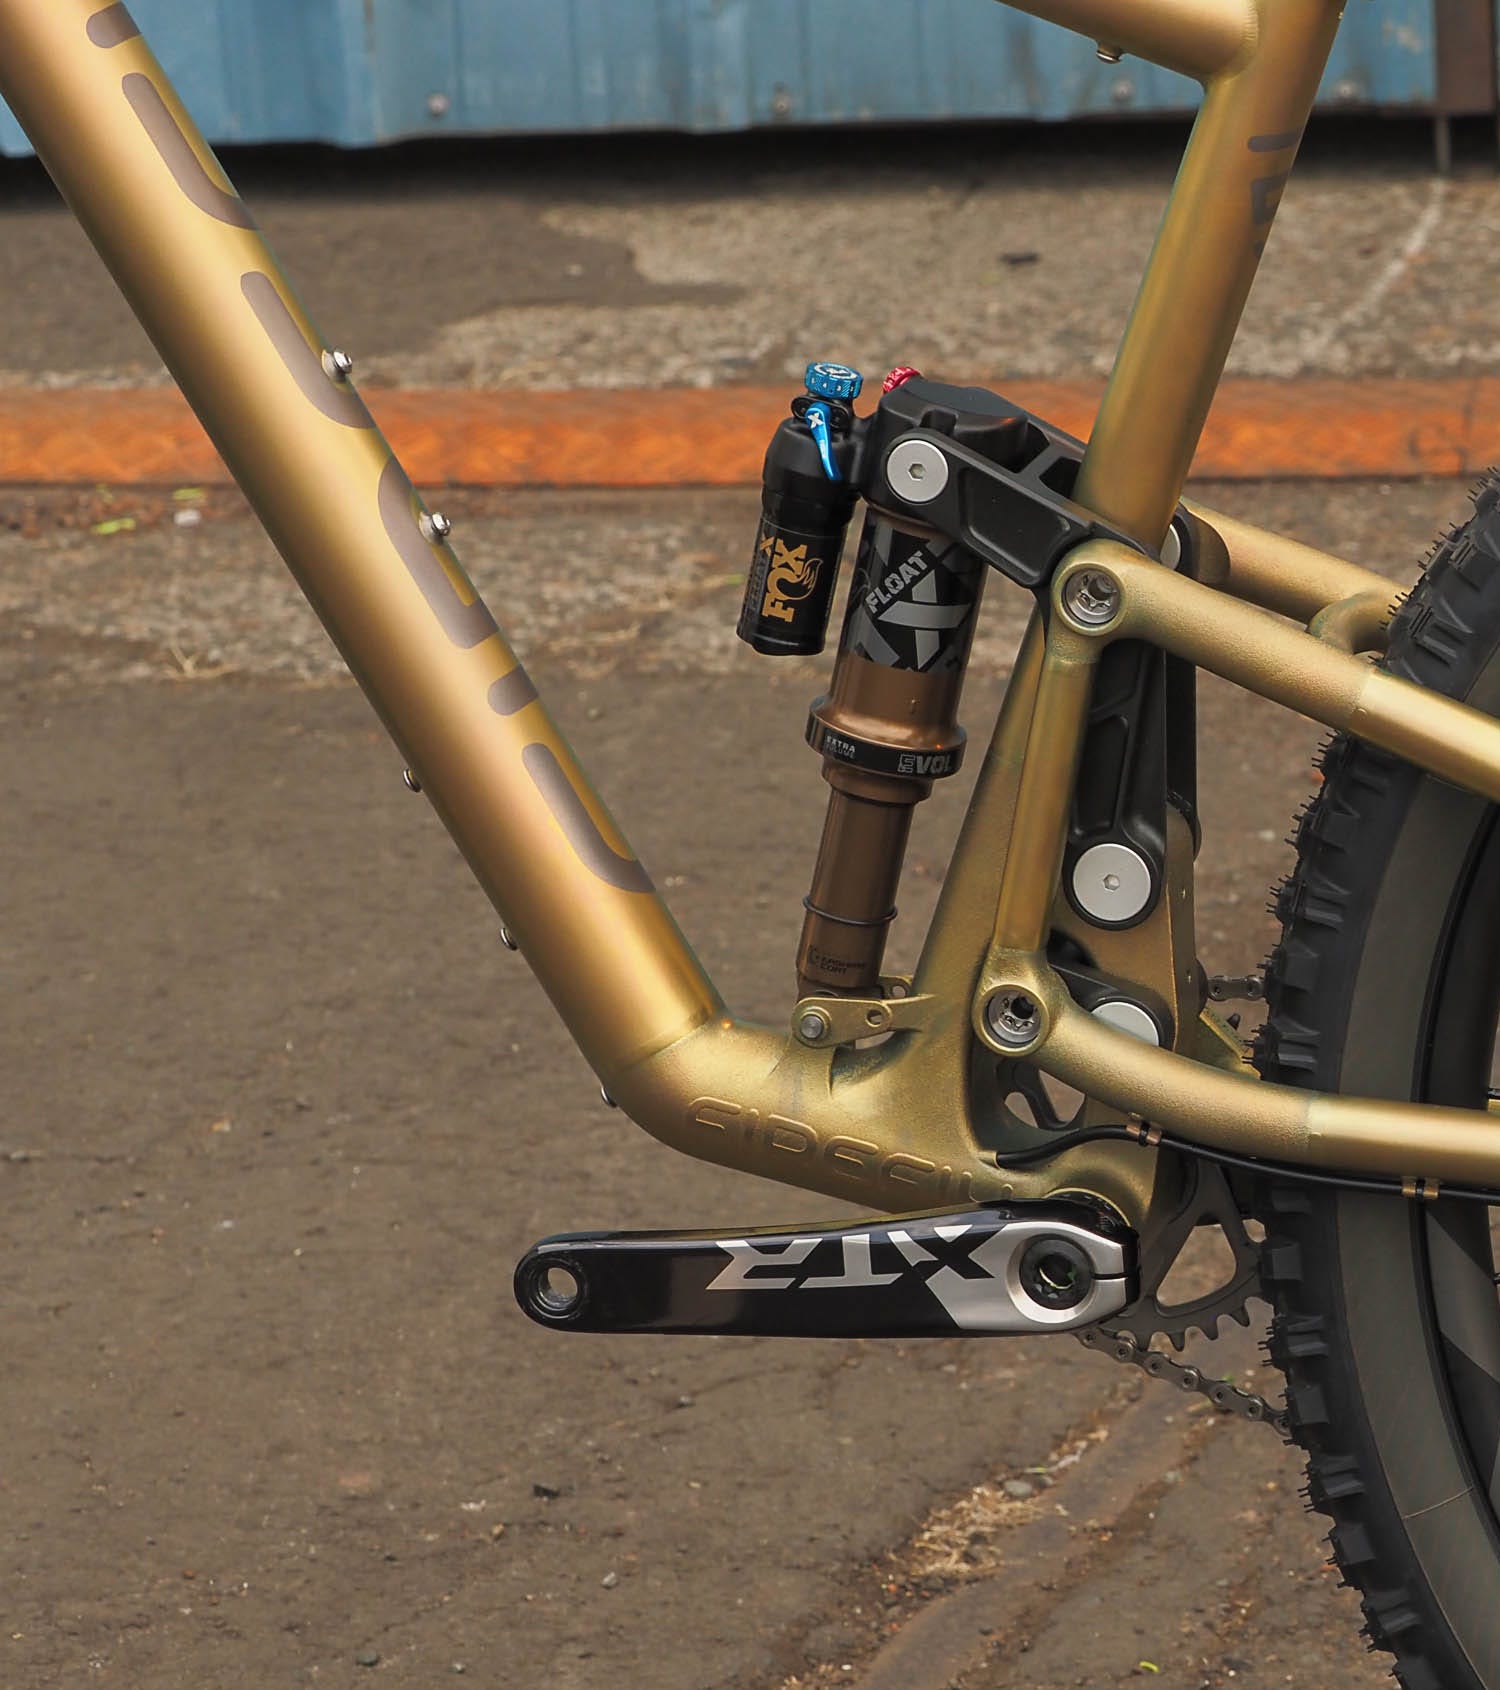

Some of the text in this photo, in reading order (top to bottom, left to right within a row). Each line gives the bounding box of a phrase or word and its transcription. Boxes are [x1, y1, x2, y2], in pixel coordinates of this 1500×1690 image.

[761, 539, 822, 623] FOX
[867, 550, 929, 612] FLOAT
[826, 735, 857, 753] EXTRA
[898, 754, 953, 774] EVOL
[706, 1224, 1008, 1291] XTR
